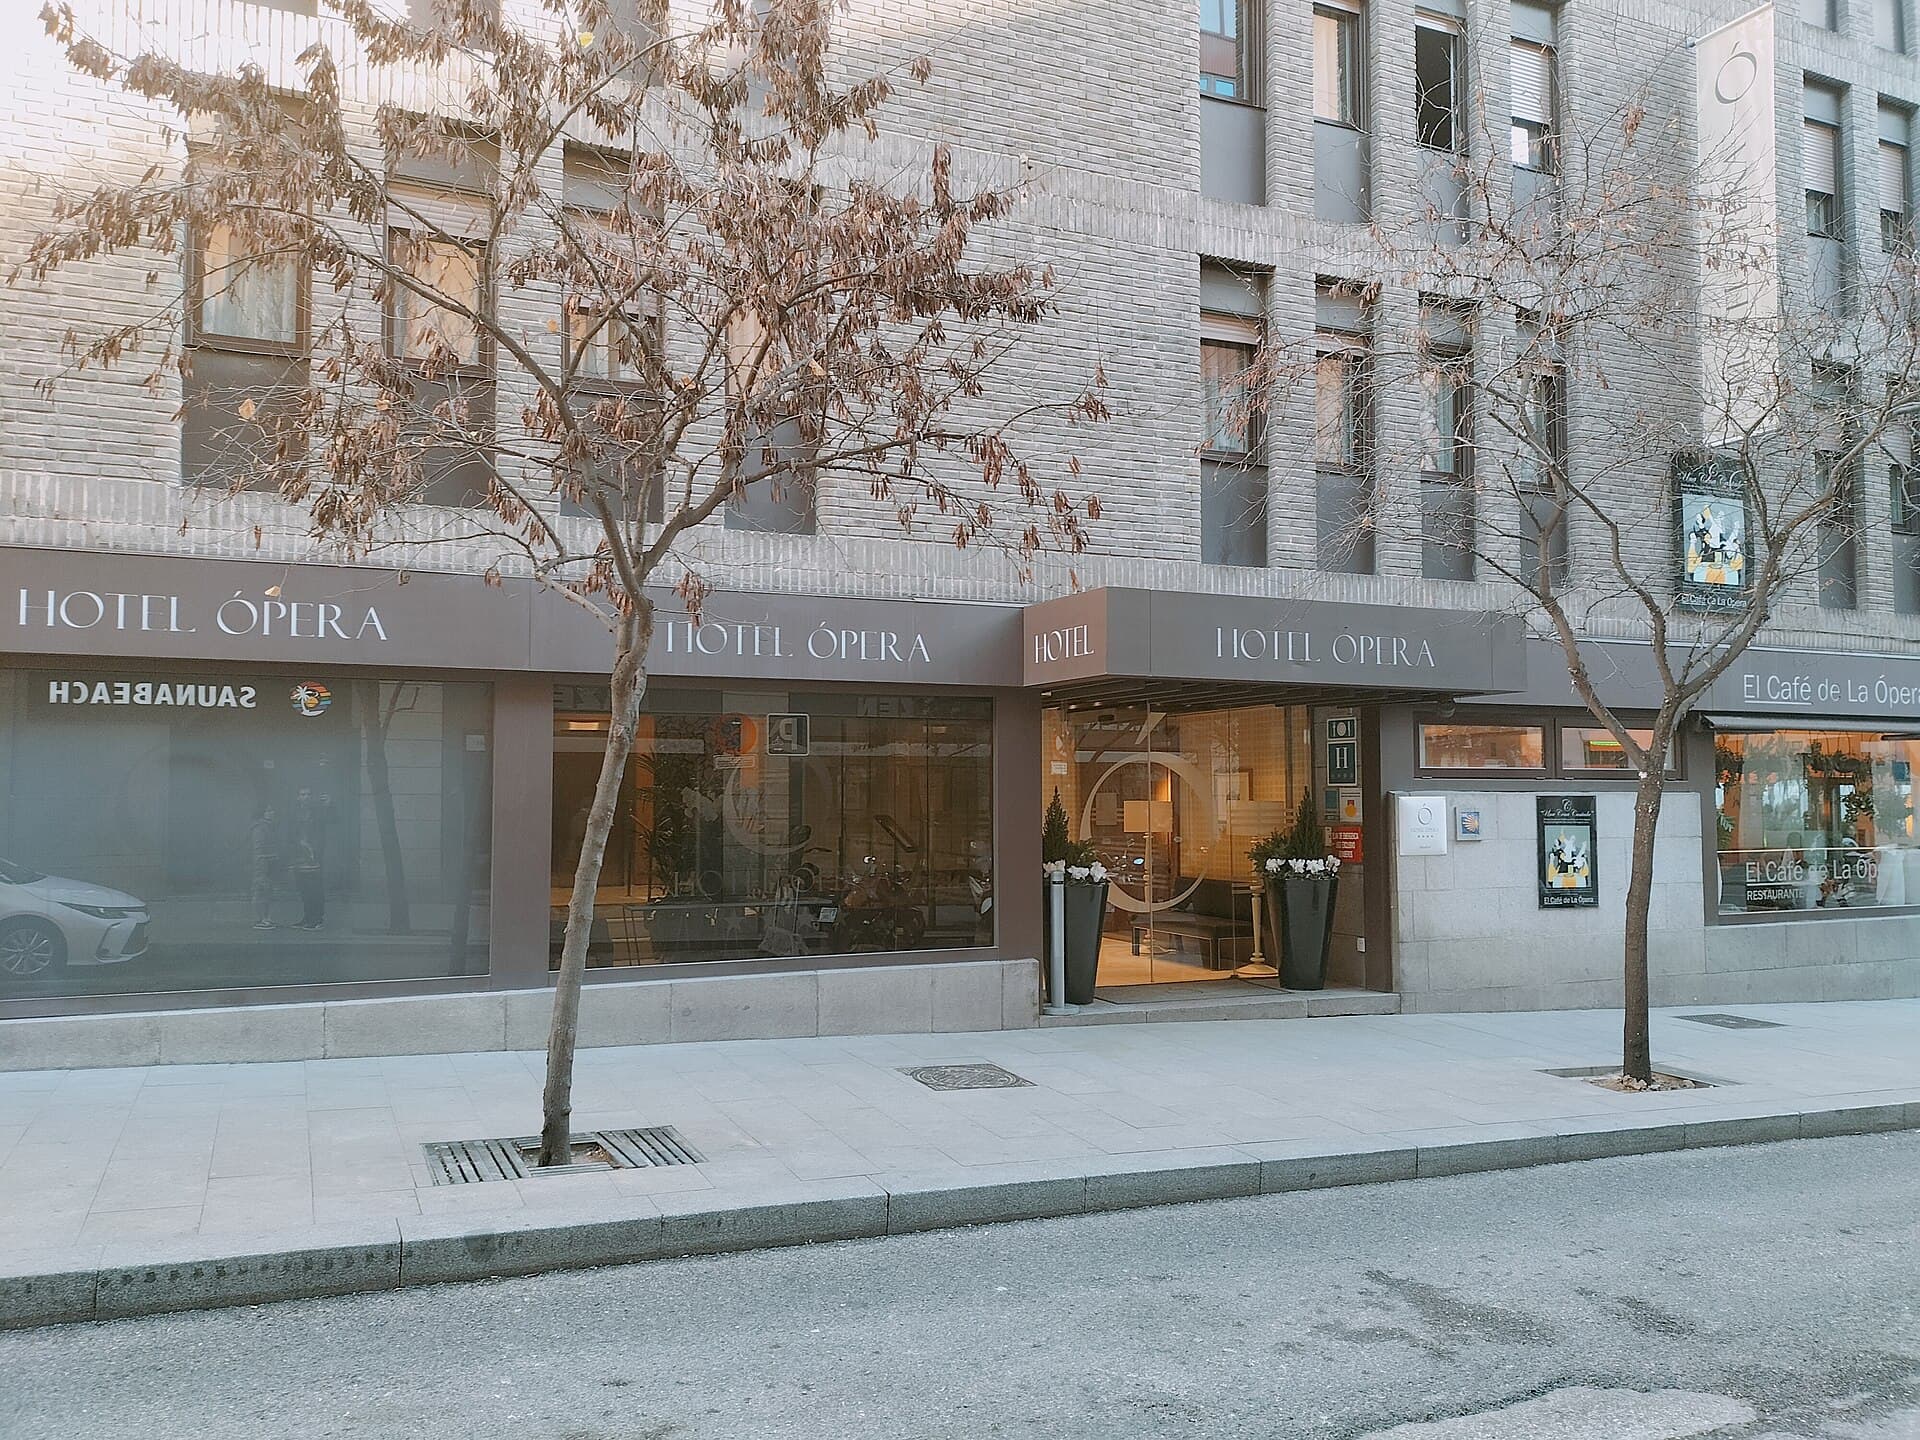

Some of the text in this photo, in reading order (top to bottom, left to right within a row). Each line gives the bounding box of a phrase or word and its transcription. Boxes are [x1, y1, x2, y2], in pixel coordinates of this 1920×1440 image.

[18, 588, 388, 641] HOTEL ÓPERA
[666, 620, 931, 663] HOTEL ÓPERA
[1034, 624, 1095, 664] HOTEL
[1217, 627, 1321, 662] HOTEL
[1744, 674, 1920, 708] El Café de La Óper
[1335, 747, 1348, 769] H
[1746, 861, 1761, 883] El
[1765, 860, 1803, 882] Café
[1834, 859, 1852, 880] La
[1747, 887, 1804, 901] RESTAURANTE
